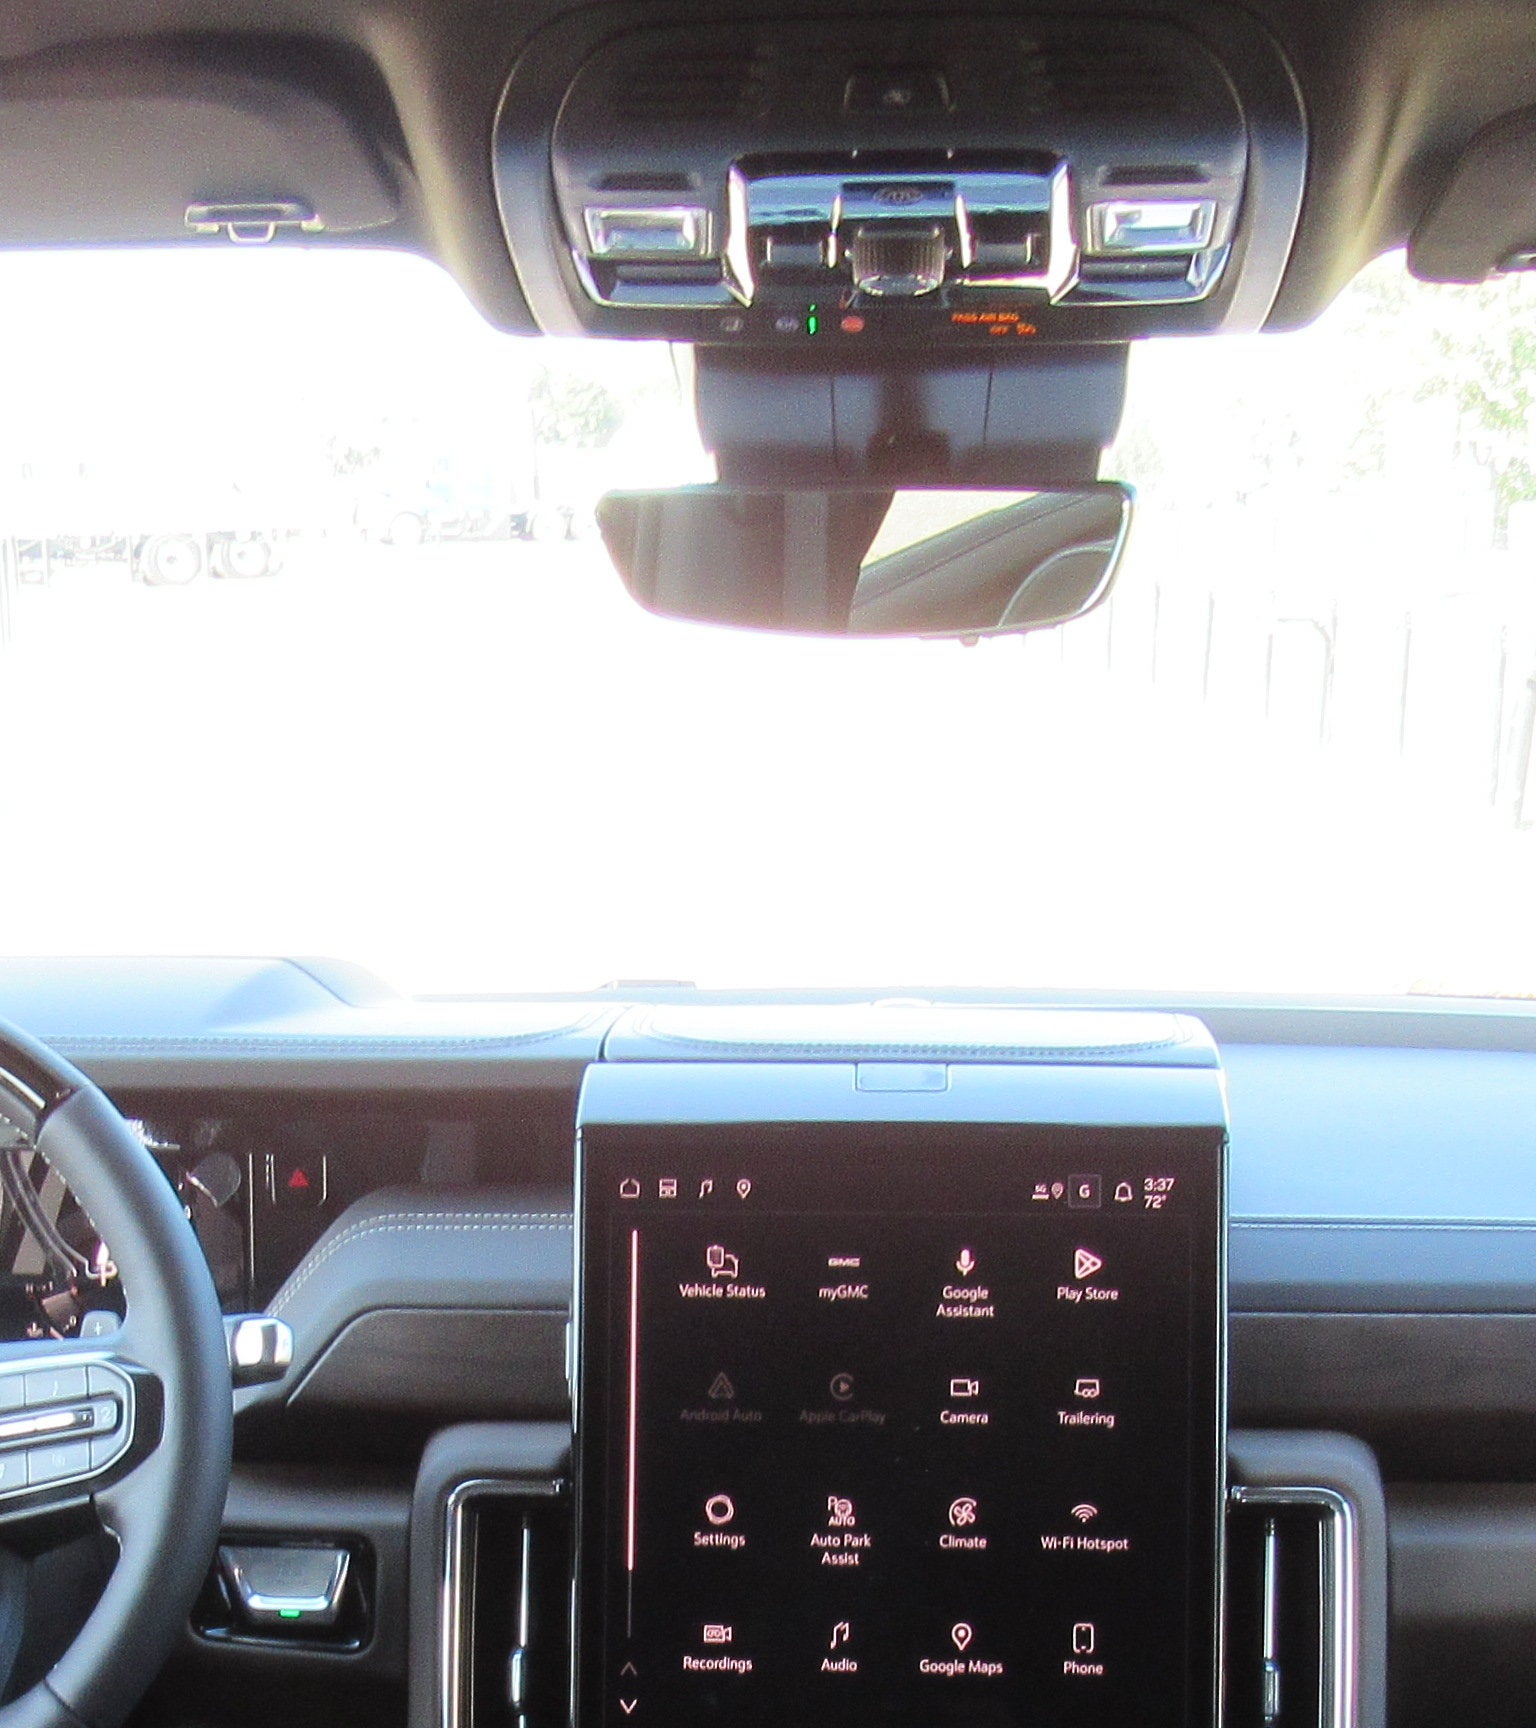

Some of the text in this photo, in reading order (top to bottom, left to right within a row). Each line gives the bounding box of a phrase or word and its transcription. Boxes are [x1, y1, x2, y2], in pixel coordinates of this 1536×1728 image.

[1078, 1184, 1091, 1199] G
[1144, 1177, 1175, 1192] 3:37
[678, 1283, 767, 1298] Vehicle Status
[818, 1284, 869, 1302] myGMC
[942, 1285, 989, 1303] Google
[1056, 1286, 1119, 1303] Play Store
[935, 1303, 995, 1318] Assistant
[680, 1408, 762, 1423] Android Auto
[799, 1409, 887, 1426] Apple CarPlay
[939, 1410, 989, 1425] Camera
[1057, 1410, 1115, 1429] Trailering
[693, 1532, 746, 1550] Settings
[810, 1533, 872, 1548] Auto Park
[939, 1534, 988, 1550] Climate
[1040, 1535, 1129, 1554] Wi-Fi Hotspot
[821, 1551, 860, 1566] Assist
[682, 1655, 753, 1674] Recordings
[820, 1658, 858, 1673] Audio
[919, 1659, 1004, 1678] Google Maps
[1063, 1660, 1104, 1676] Phone
